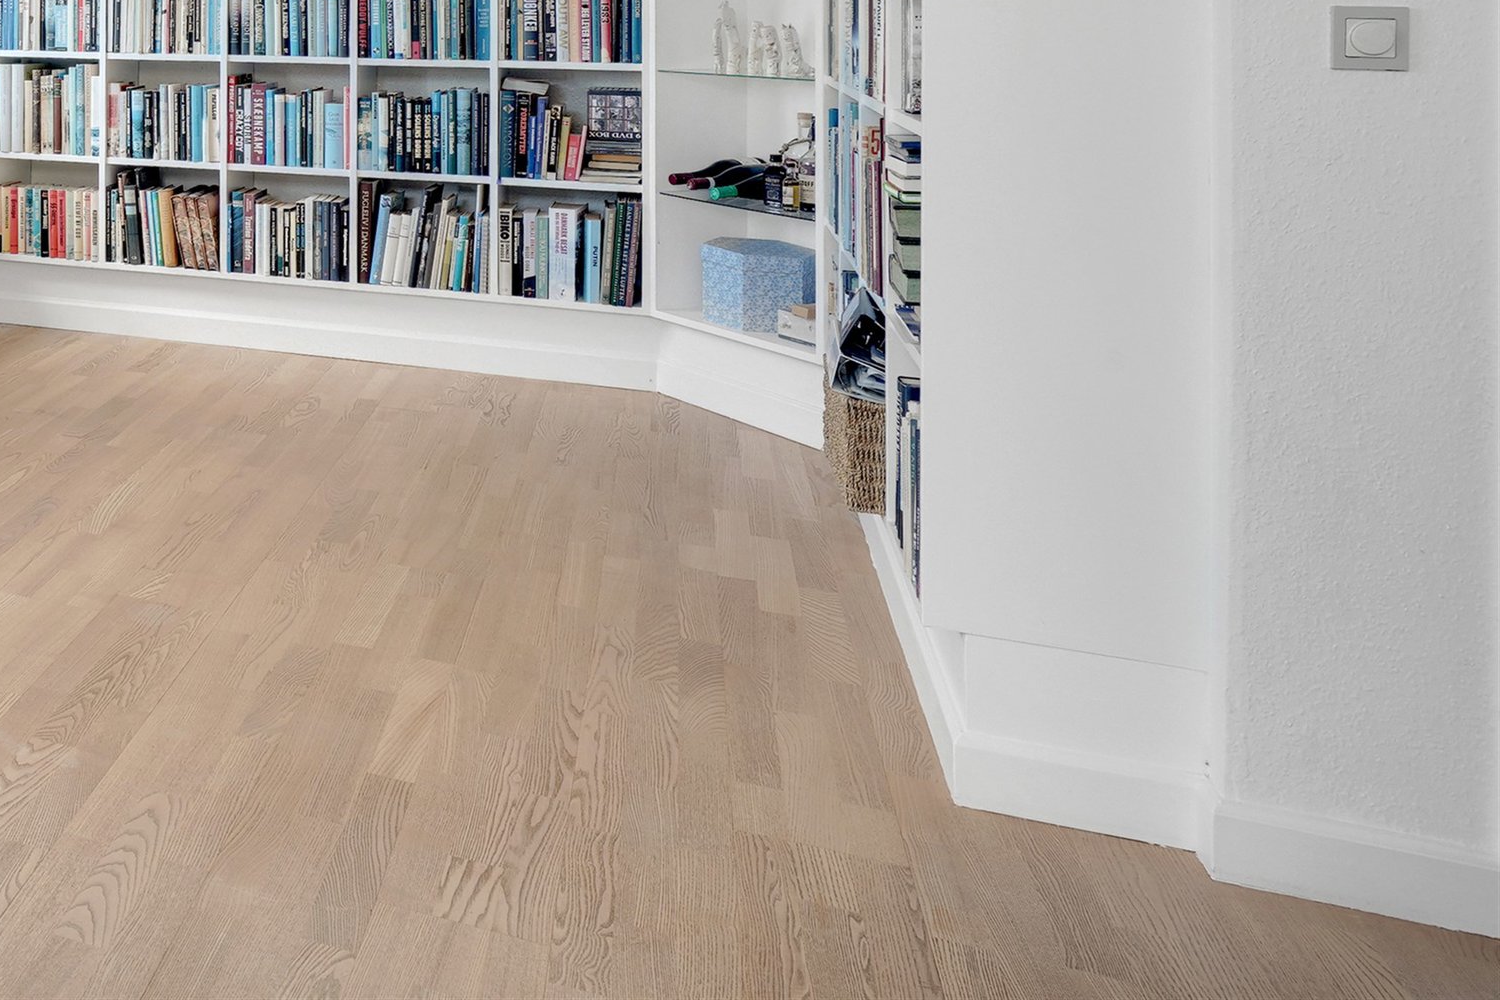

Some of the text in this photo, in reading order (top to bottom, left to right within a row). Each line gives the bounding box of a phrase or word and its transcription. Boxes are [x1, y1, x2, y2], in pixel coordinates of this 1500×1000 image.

[358, 23, 367, 48] WULFF
[235, 109, 244, 136] CRAZY
[244, 114, 252, 144] STORM
[253, 98, 264, 155] SKÆBNEKAMP
[588, 131, 610, 139] BOX
[503, 116, 513, 168] NAPOLEON
[361, 190, 370, 227] FUGLELIV
[499, 214, 511, 240] BIKO
[360, 231, 369, 273] DANMARK
[618, 275, 626, 301] LUFTEN
